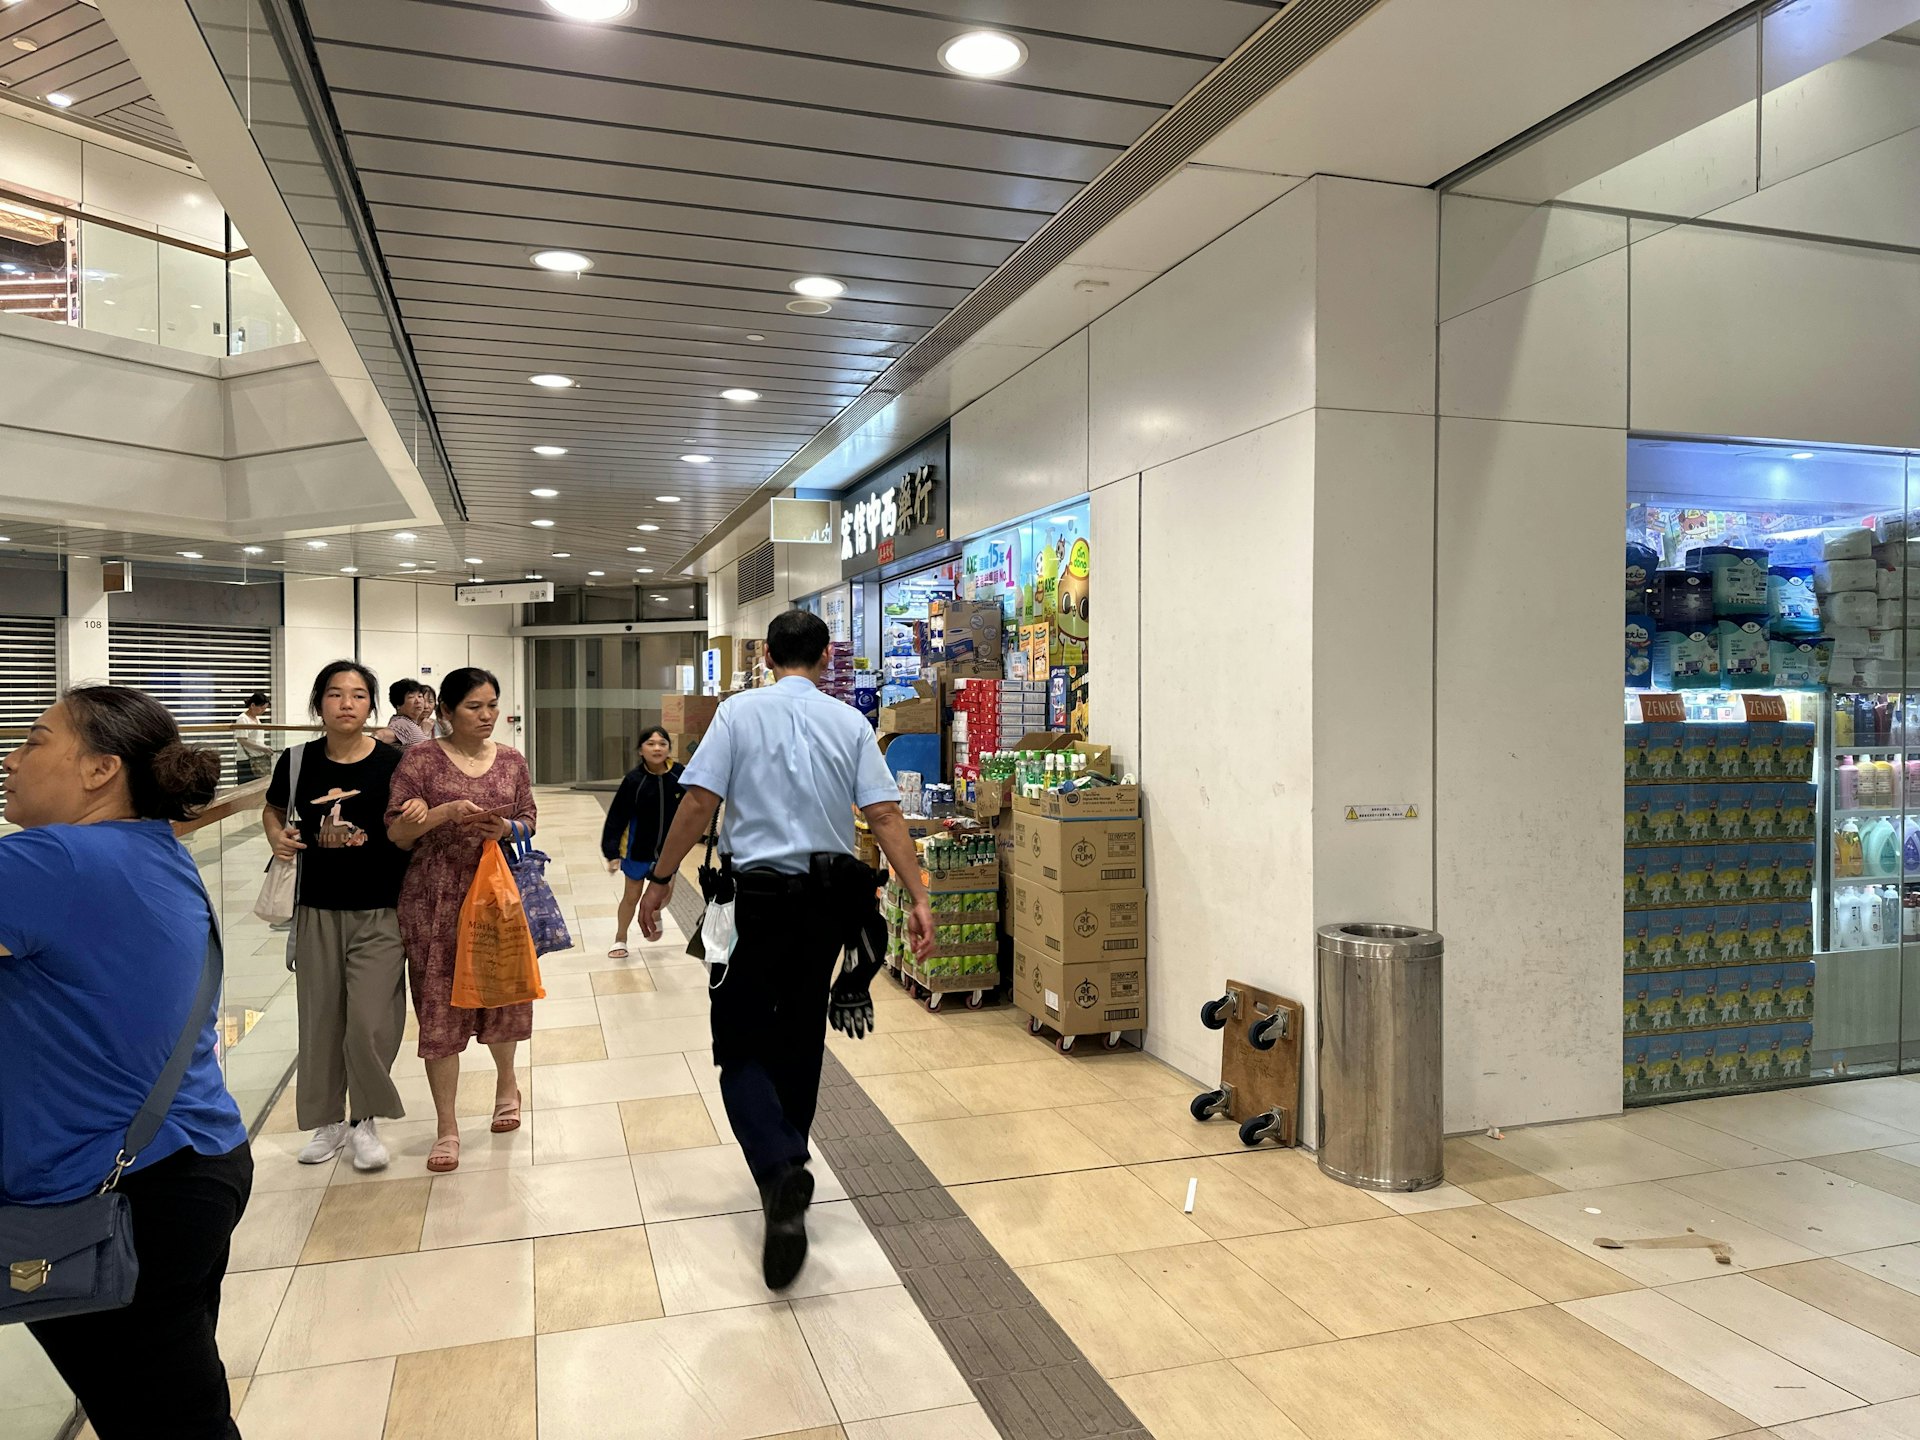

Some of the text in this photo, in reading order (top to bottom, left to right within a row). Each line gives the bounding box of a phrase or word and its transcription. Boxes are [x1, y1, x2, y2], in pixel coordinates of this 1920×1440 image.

[966, 555, 978, 574] AXE
[1045, 577, 1056, 591] AXE
[84, 620, 102, 629] 108
[1646, 700, 1681, 716] ZENSES
[1749, 700, 1783, 716] ZENSES
